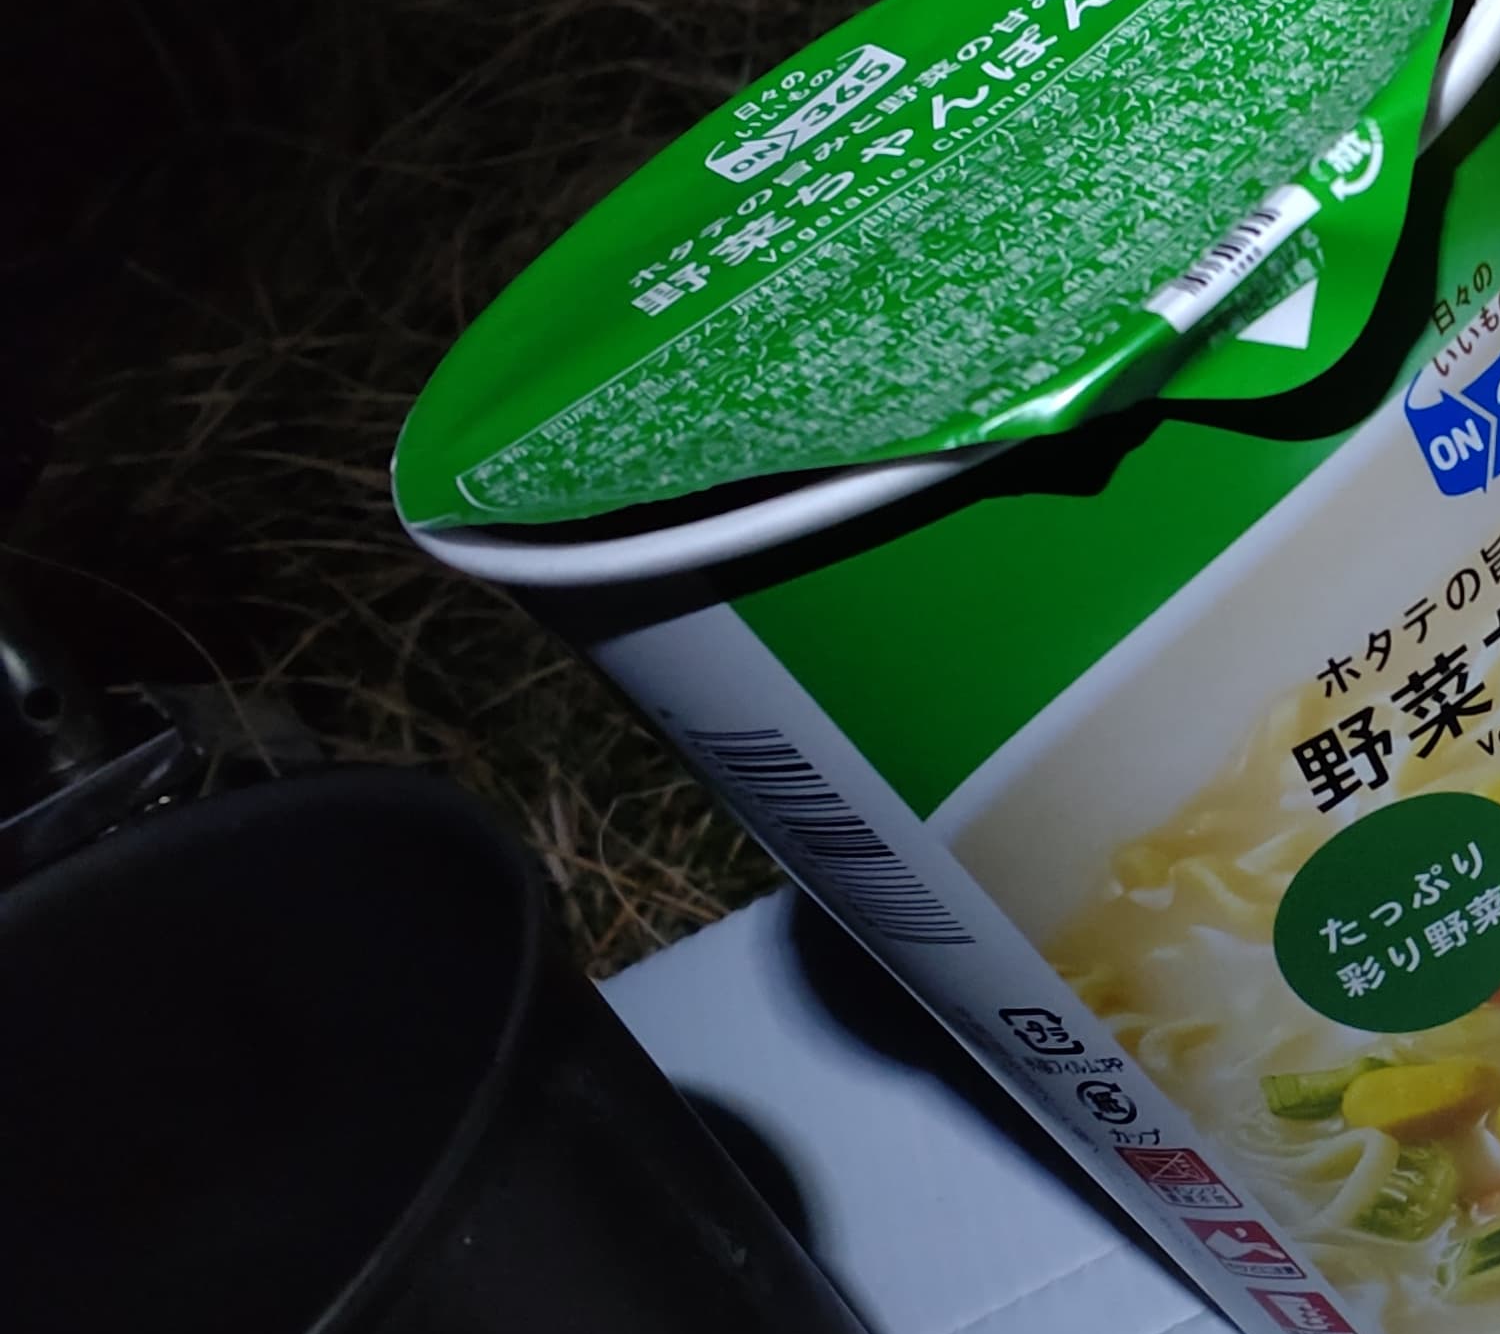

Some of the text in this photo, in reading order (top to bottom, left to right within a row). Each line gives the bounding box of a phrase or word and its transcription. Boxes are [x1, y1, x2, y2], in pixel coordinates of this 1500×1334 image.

[729, 58, 893, 174] ON 365
[733, 70, 806, 122] 日々の
[757, 156, 927, 265] Vegetables
[931, 56, 1067, 153] Champon
[1430, 262, 1493, 336] 日々の
[1429, 418, 1485, 472] ON
[1318, 840, 1487, 954] たっぷり
